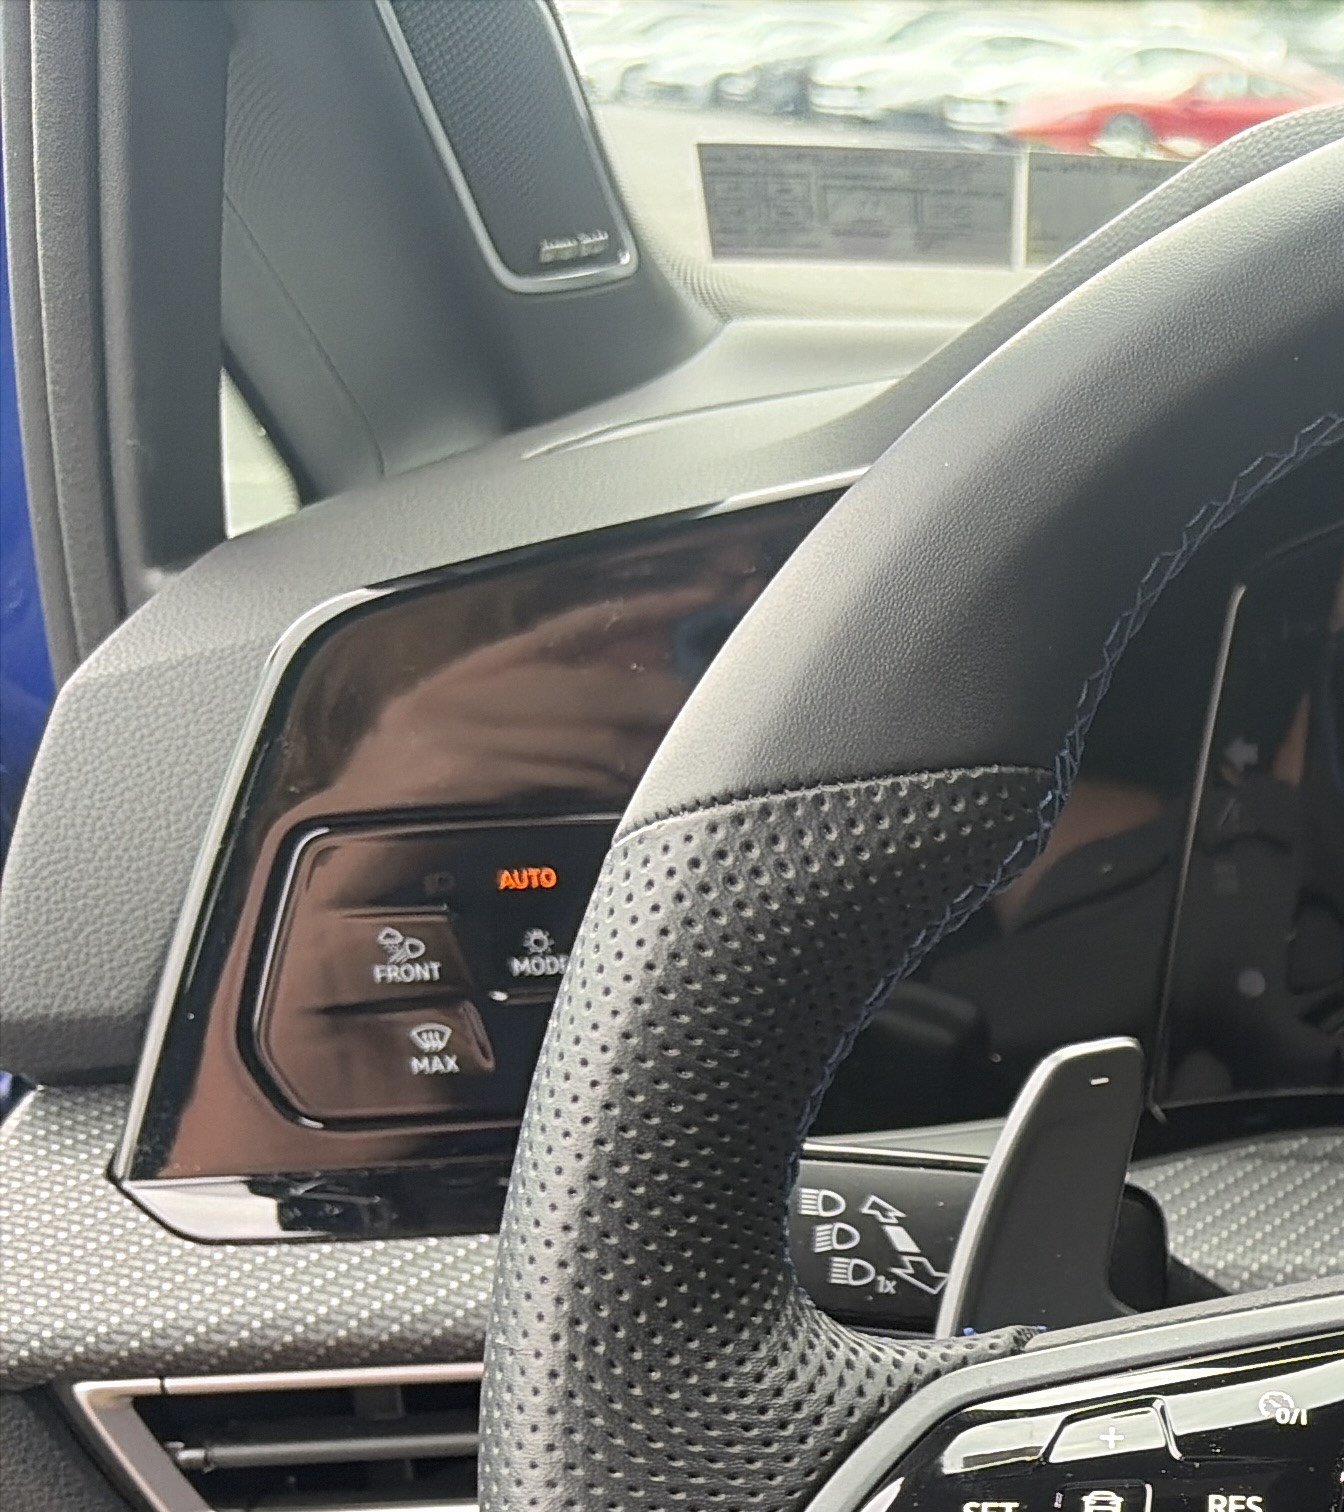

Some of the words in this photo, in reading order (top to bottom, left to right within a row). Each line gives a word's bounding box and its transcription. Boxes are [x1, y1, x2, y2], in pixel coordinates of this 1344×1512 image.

[498, 867, 558, 890] AUTO
[374, 961, 441, 984] FRONT
[410, 1055, 460, 1075] MAX
